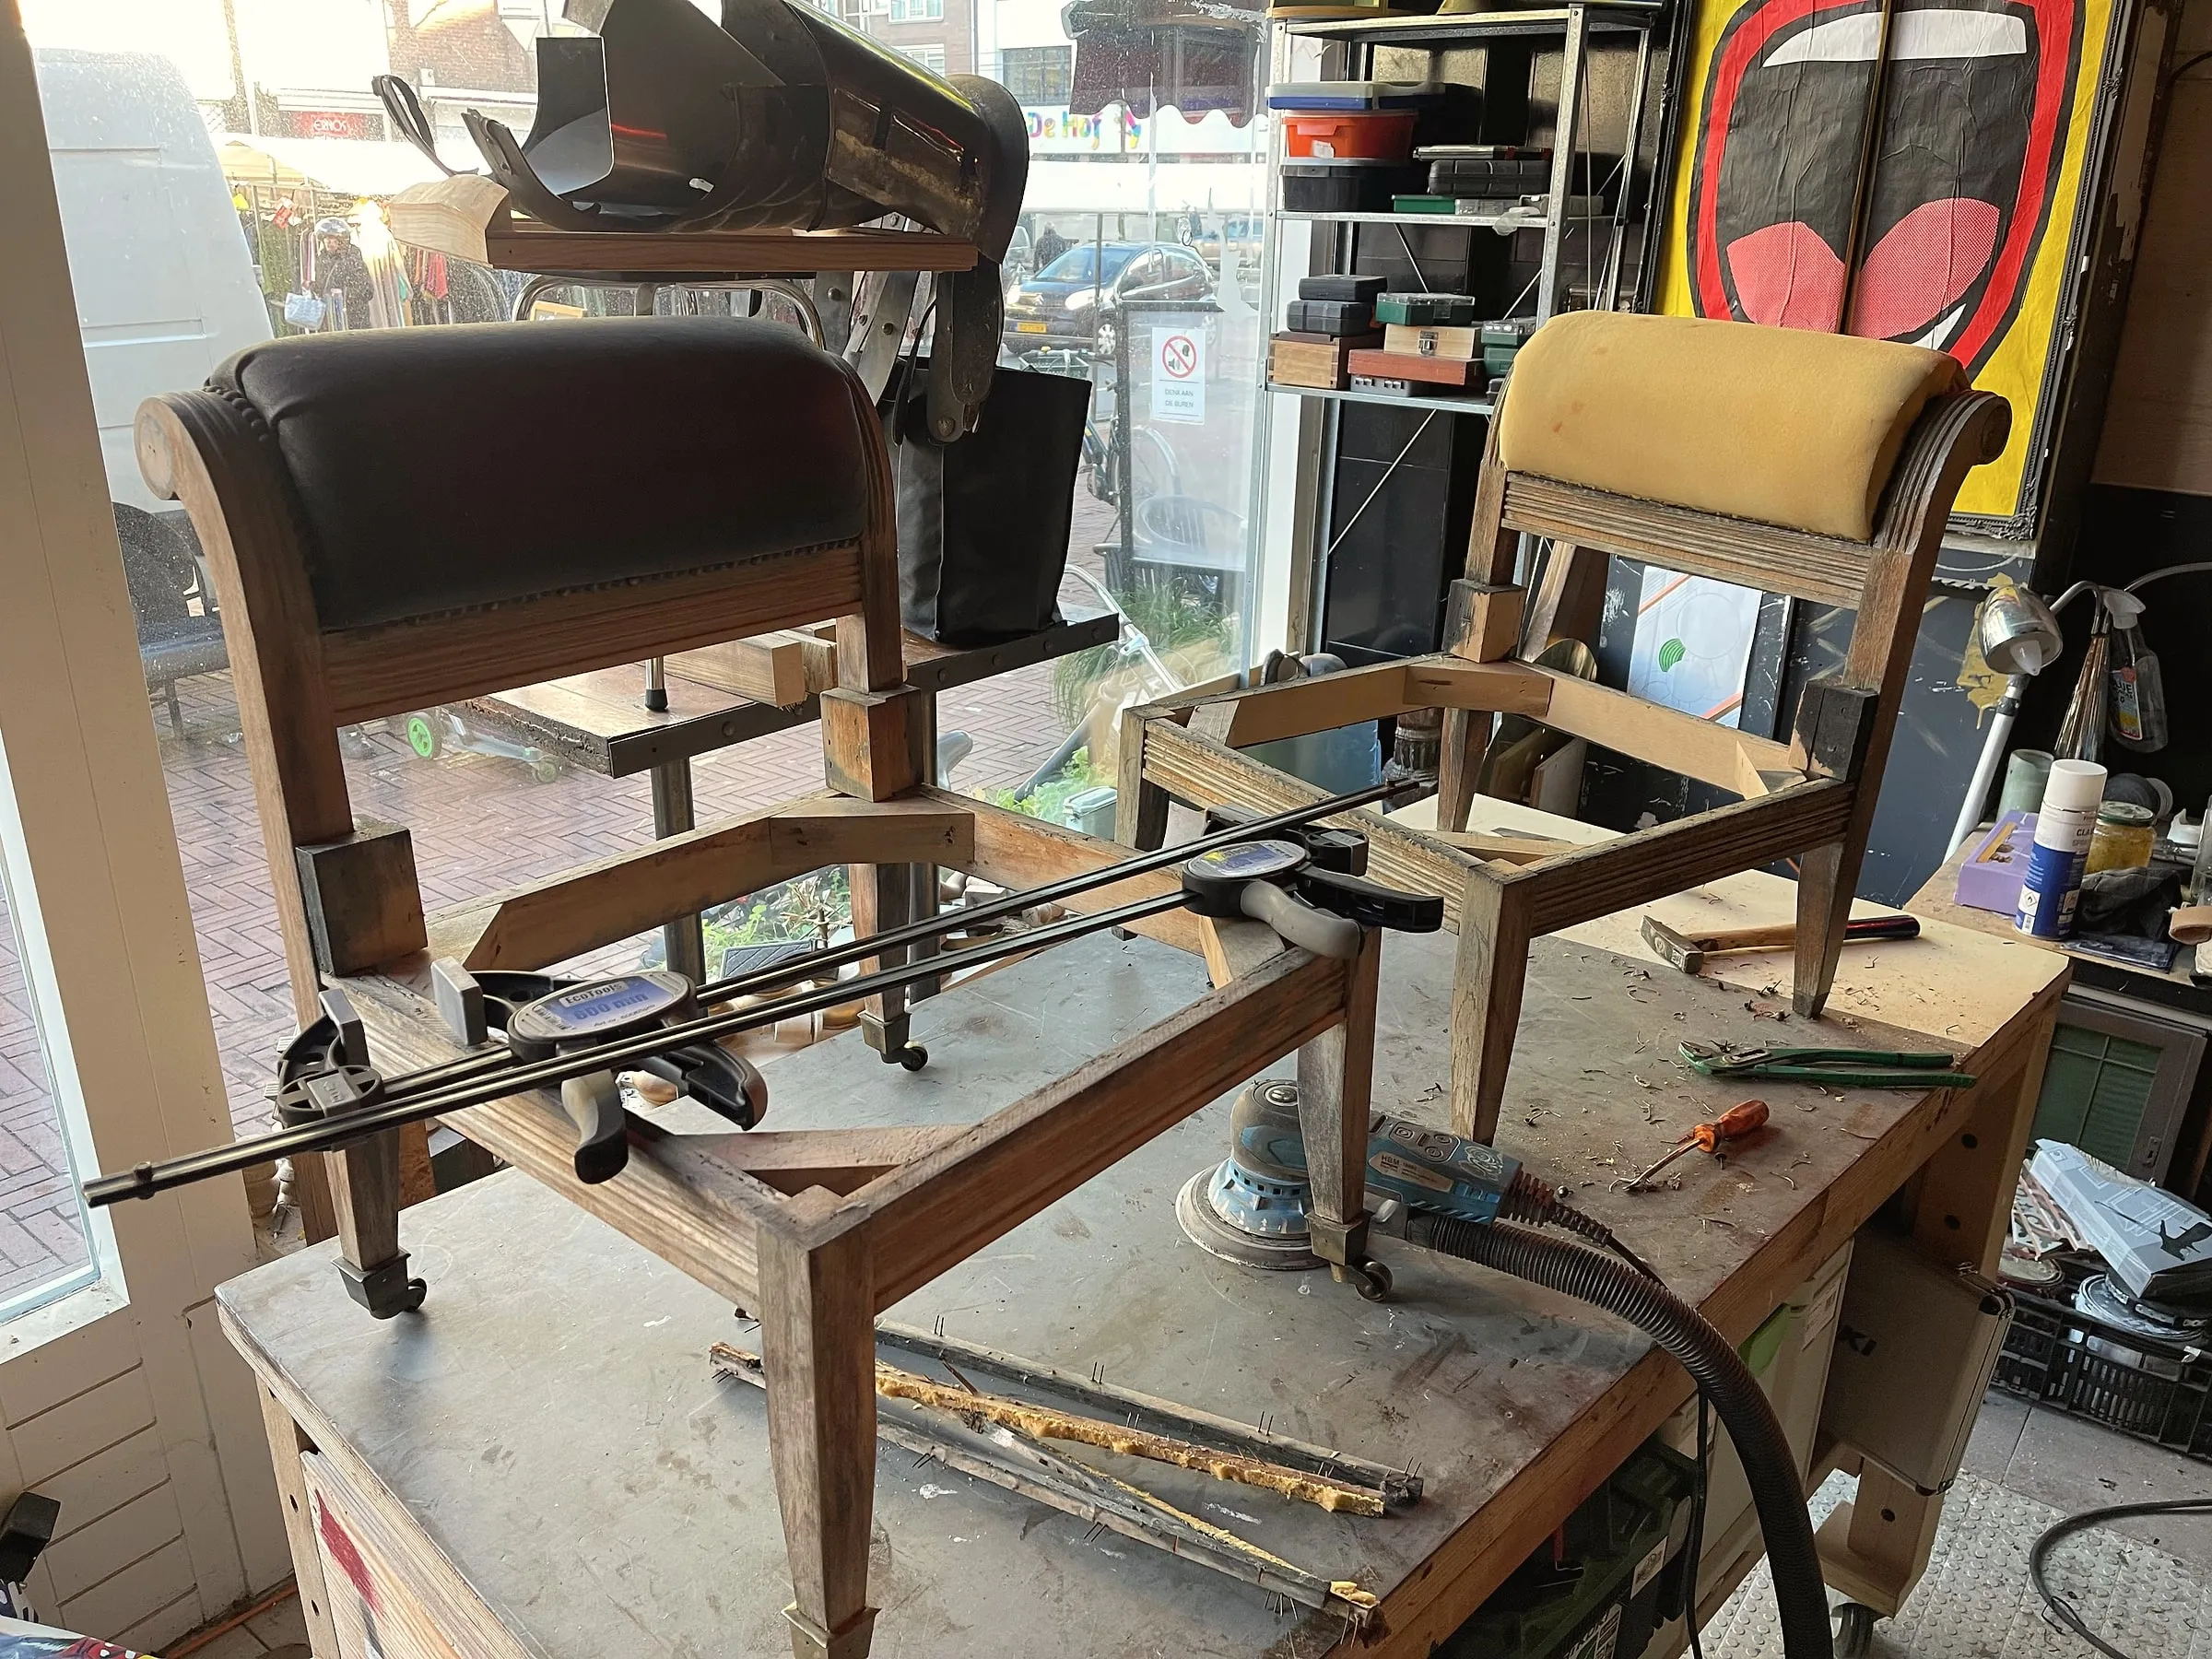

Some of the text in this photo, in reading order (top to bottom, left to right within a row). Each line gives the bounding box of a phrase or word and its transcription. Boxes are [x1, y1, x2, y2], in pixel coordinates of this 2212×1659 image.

[1028, 112, 1103, 150] De Hof
[565, 983, 623, 1005] EcoTools
